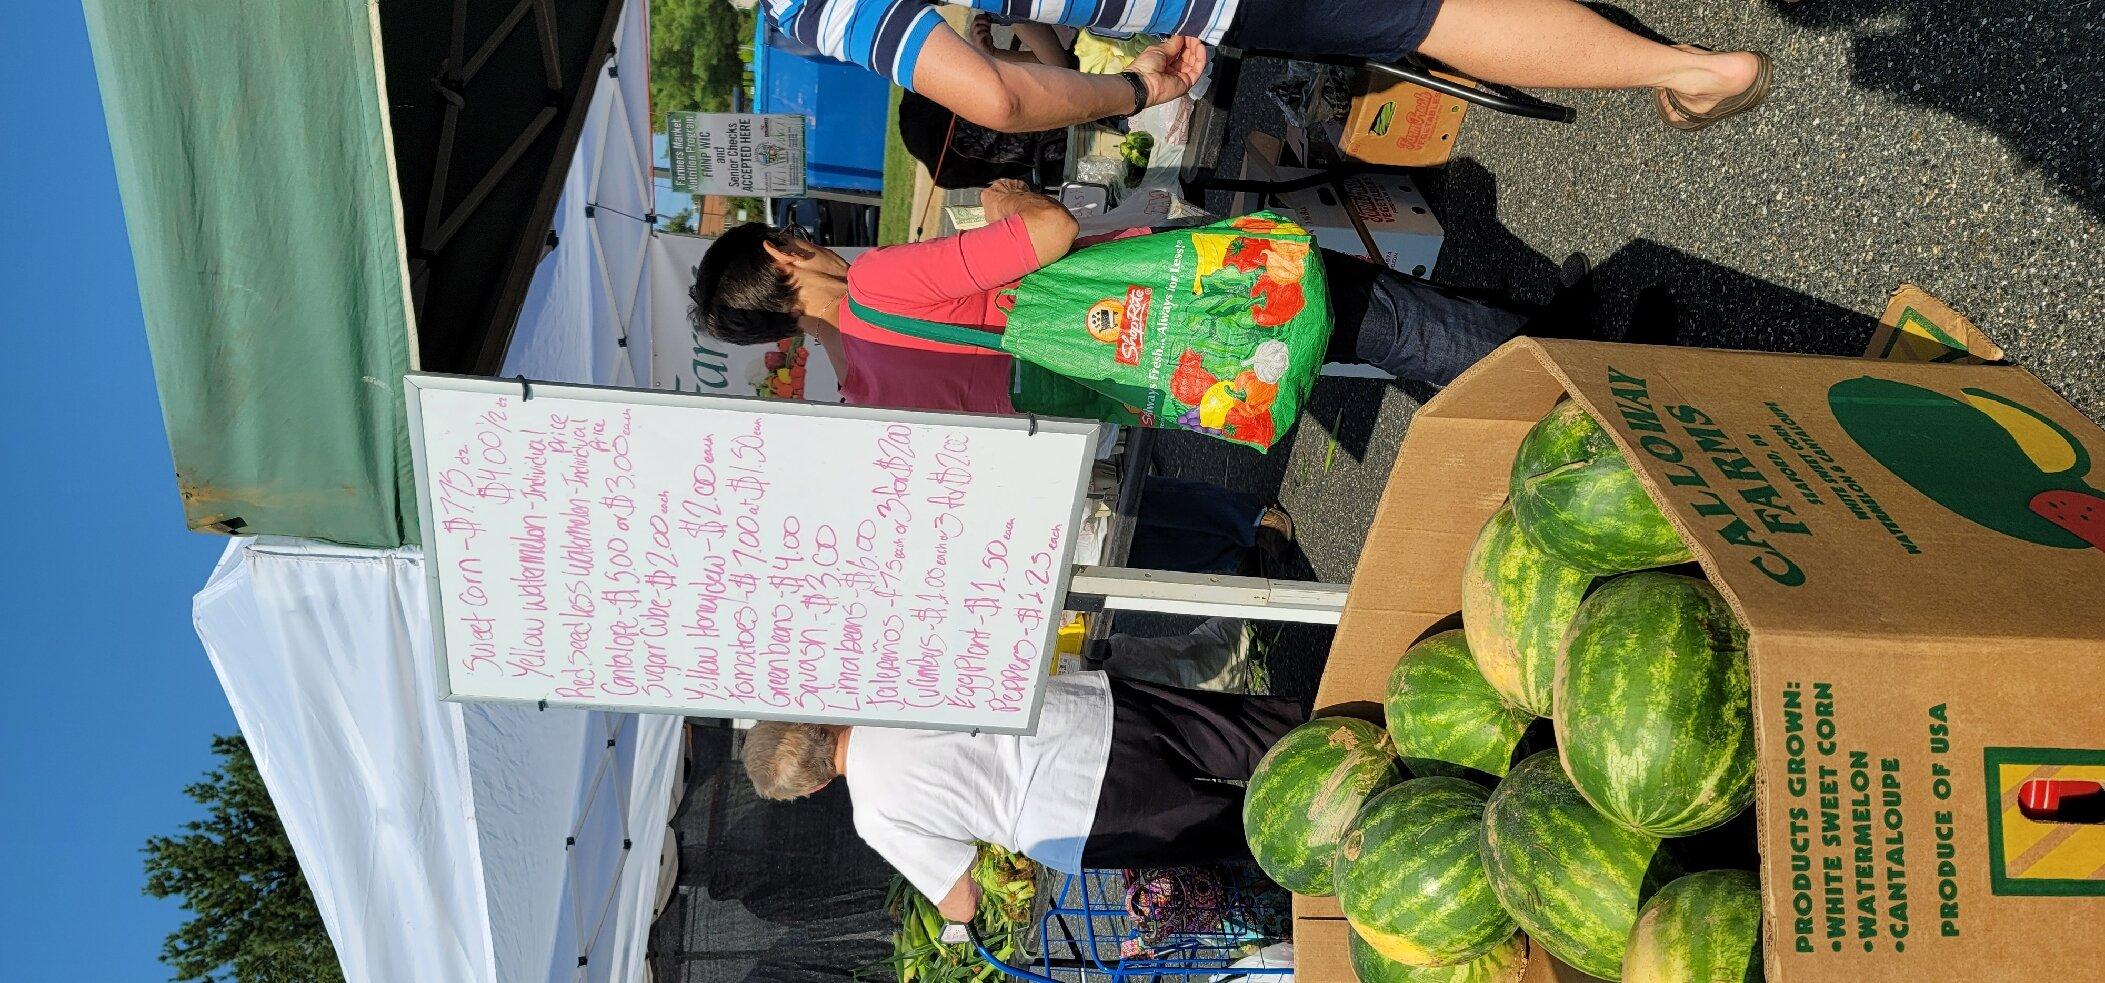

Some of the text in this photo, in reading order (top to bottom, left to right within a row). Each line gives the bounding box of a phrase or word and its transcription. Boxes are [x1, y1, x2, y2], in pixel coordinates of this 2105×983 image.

[671, 119, 686, 186] Farmers Market
[685, 116, 698, 190] Nutrition Program
[699, 131, 714, 178] FMNP WIC
[713, 147, 726, 164] and
[725, 123, 740, 187] Senior Checks
[739, 118, 754, 192] ACCEPTED HERE
[1156, 294, 1179, 334] Always
[1165, 275, 1179, 292] for
[1121, 289, 1145, 363] ShopRite
[622, 408, 632, 435] each
[703, 433, 714, 463] each
[1746, 433, 1769, 447] DE
[476, 431, 515, 504] $4.00
[598, 435, 636, 516] $3.00
[725, 435, 770, 500] $1.50
[871, 472, 910, 499] for
[1607, 365, 1806, 587] CALLOWAY
[1662, 404, 1813, 536] FARMS
[1763, 401, 1922, 555] WATERMELON & CANTALOUPE
[1769, 424, 1871, 520] WHITE SWEET CORN
[613, 514, 629, 531] or
[876, 498, 911, 522] 3
[894, 519, 908, 535] or
[934, 513, 964, 538] 3
[1001, 517, 1016, 540] each
[1048, 524, 1062, 550] each
[458, 558, 488, 606] Corn
[639, 598, 672, 637] Cube
[658, 491, 669, 513] each
[935, 543, 948, 565] each
[460, 612, 503, 676] Sweet
[506, 618, 555, 678] Yellow
[600, 617, 640, 695] Cantalope
[683, 647, 727, 700] Yellow
[724, 606, 758, 703] Tomatoes
[794, 628, 836, 711] Squash
[555, 668, 595, 698] Red
[1813, 682, 1837, 756] CORN
[1783, 681, 1814, 953] PRODUCTS GROWN:
[1819, 765, 1842, 847] SWEET
[1928, 703, 1960, 937] PRODUCE OF USA
